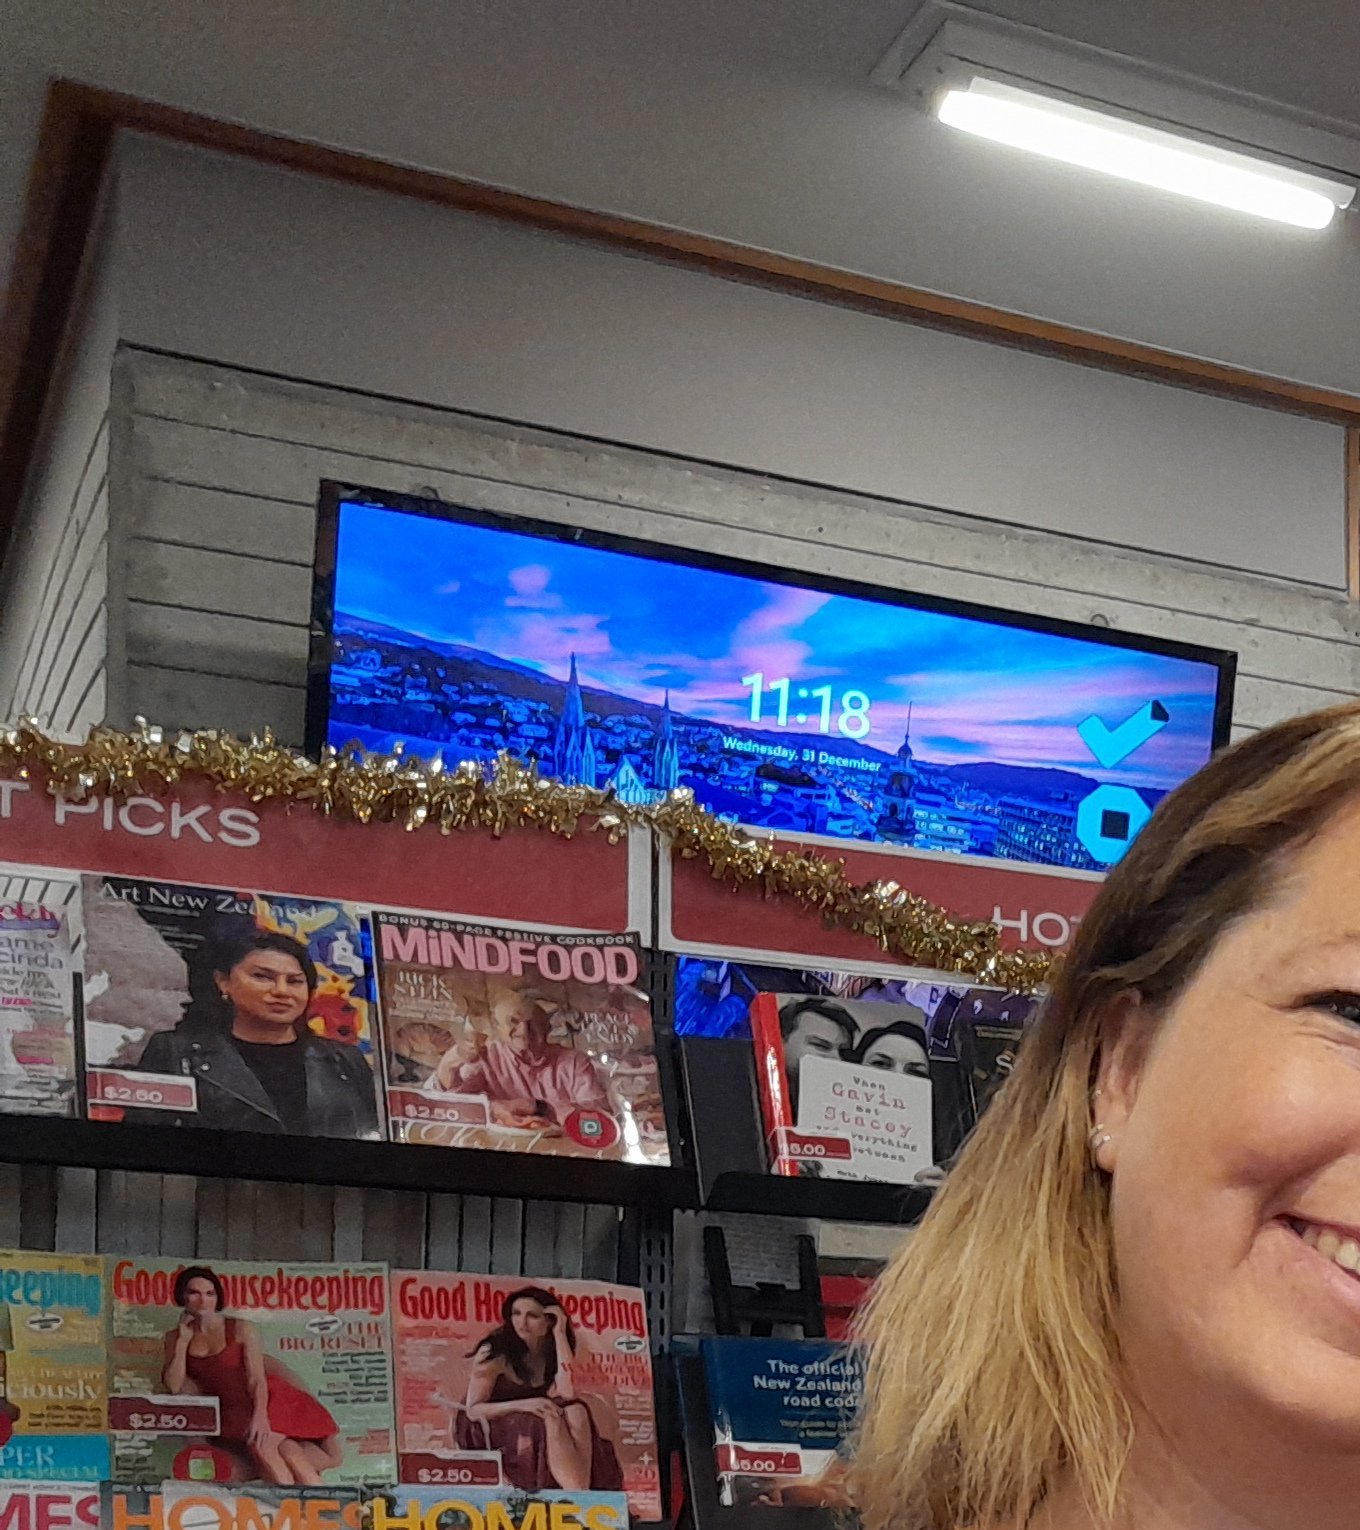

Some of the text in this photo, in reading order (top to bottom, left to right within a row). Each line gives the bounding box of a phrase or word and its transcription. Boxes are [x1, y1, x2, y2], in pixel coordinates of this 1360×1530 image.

[741, 672, 871, 739] 11:18
[722, 736, 882, 772] Wednesday, 31 December
[55, 792, 260, 847] PICKS
[102, 881, 208, 909] Art New
[378, 913, 635, 947] BONUS COOKBOOK
[831, 1081, 907, 1109] Gavin
[403, 1103, 460, 1122] $2.50
[824, 1105, 913, 1138] Stacey
[400, 1276, 467, 1321] Good
[767, 1359, 861, 1377] The official
[753, 1375, 862, 1393] New Zealand
[782, 1393, 822, 1408] road
[128, 1413, 188, 1430] $2.50
[417, 1468, 473, 1484] $2.50
